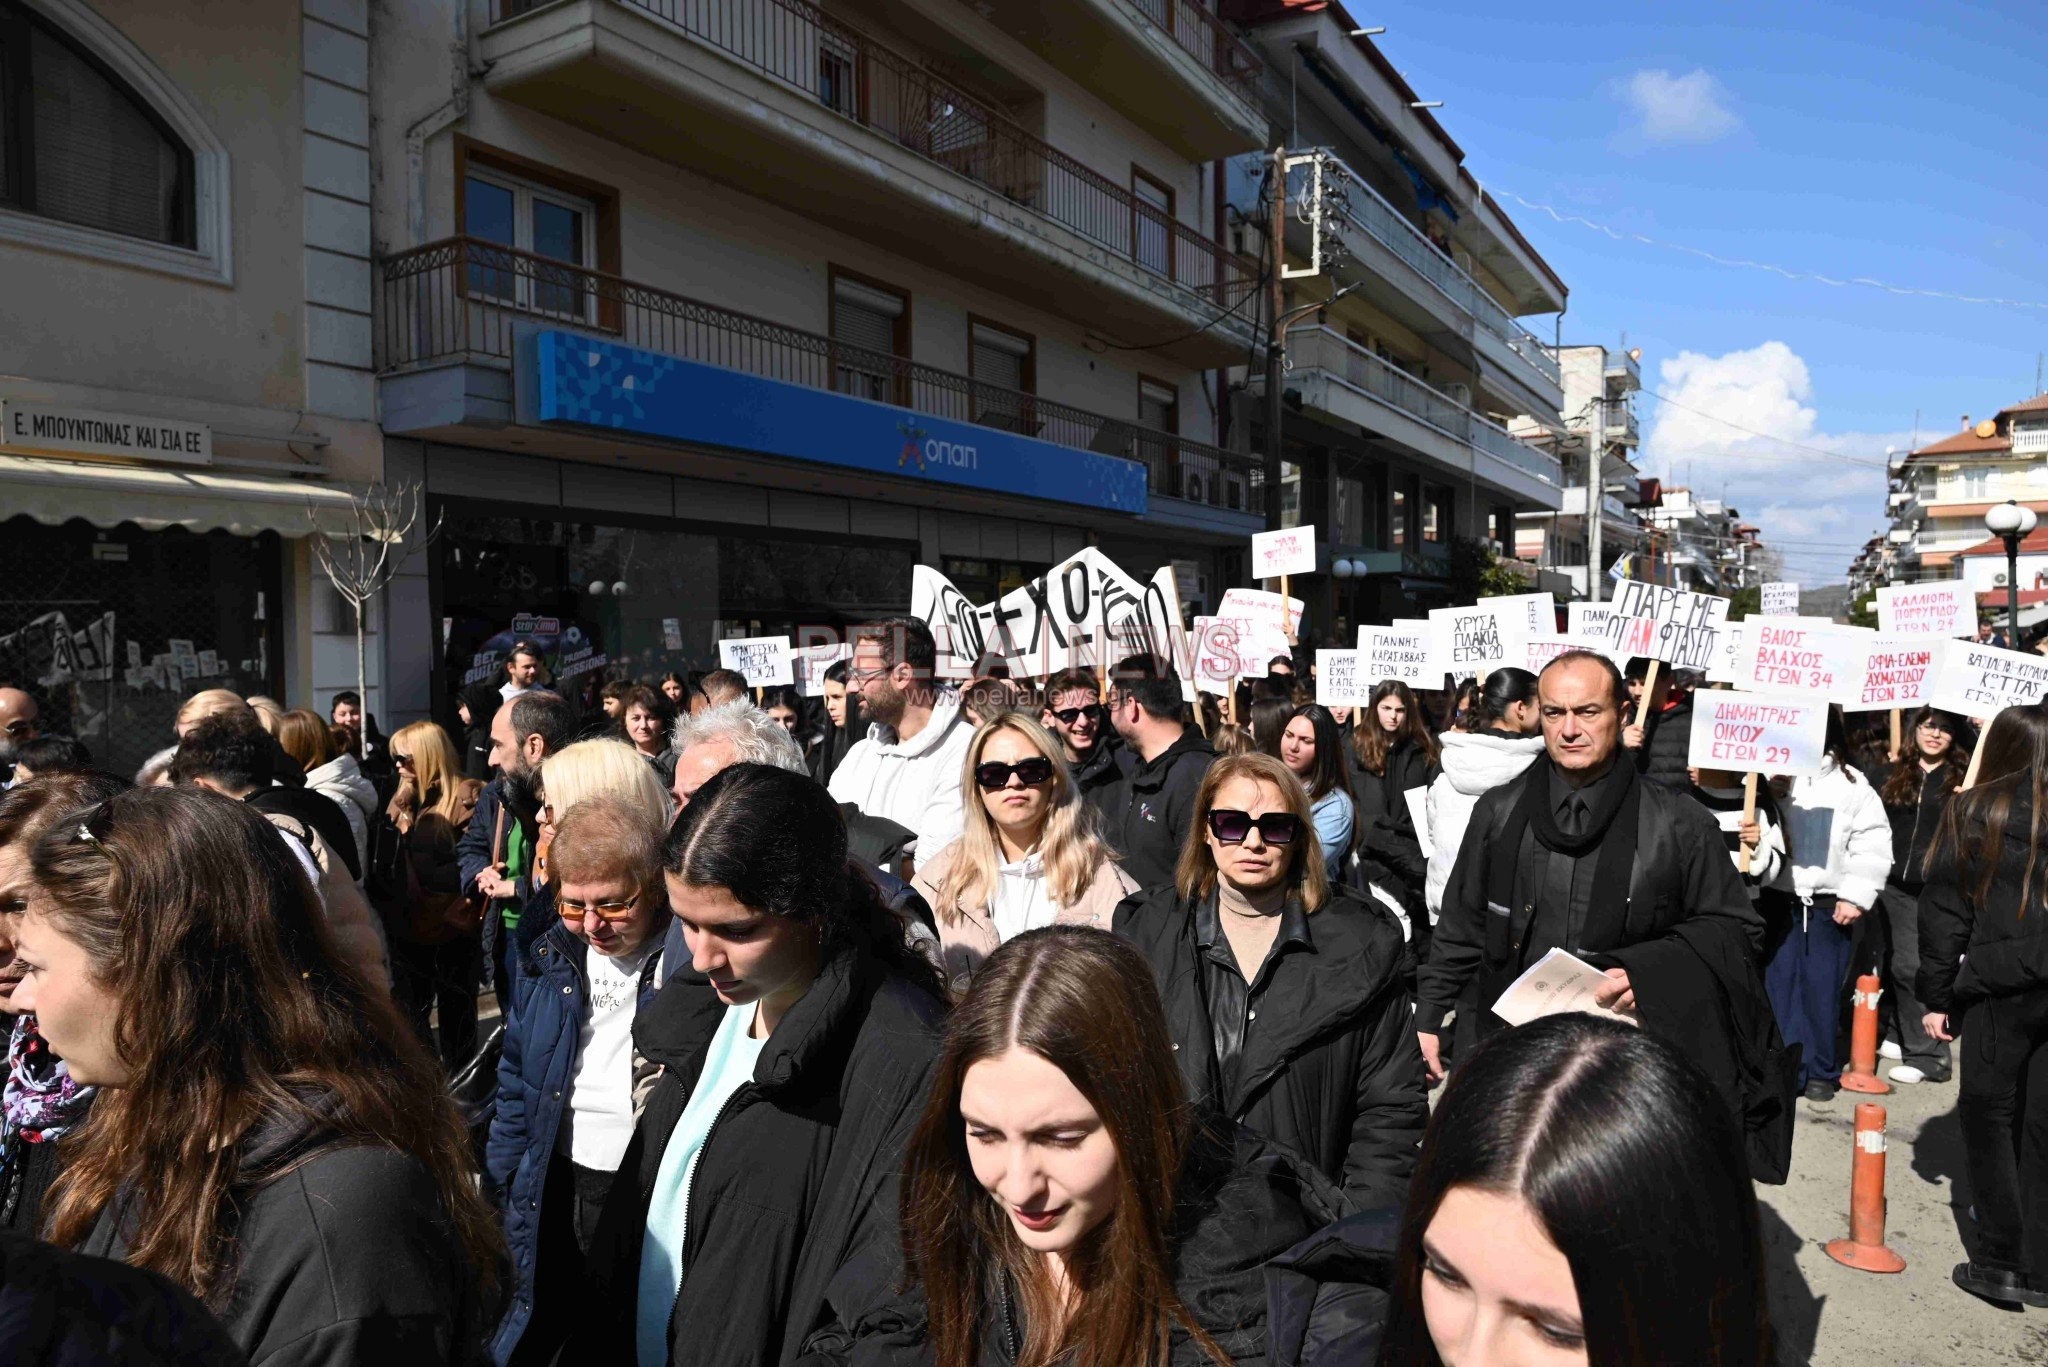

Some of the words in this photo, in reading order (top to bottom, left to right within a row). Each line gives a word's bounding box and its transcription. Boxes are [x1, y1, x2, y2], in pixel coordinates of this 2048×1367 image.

[33, 413, 132, 447] ΜΠΟΥΝΤΩΝΑΣ
[136, 426, 157, 449] ΚΑΙ
[160, 429, 183, 452] ΣΙΑ
[186, 432, 202, 453] ΕΕ
[1620, 581, 1688, 624] ΠΑΡΕ
[1687, 594, 1723, 629] ΜΕ
[1892, 592, 1954, 608] ΚΑΛΛΙΟΠΗ
[1454, 614, 1498, 632] ΧΡΥΣΑ
[1373, 634, 1420, 648] ΓΙΑΝΝΗΣ
[1454, 630, 1500, 647] ΠΛΑΚΙΑ
[1760, 626, 1807, 648] ΒΑΙΟΣ
[1371, 650, 1427, 662] ΚΑΡΑΣΑΒΒΑΣ
[1453, 645, 1487, 662] ΕΤΩΝ
[1488, 645, 1504, 660] 20
[1757, 646, 1824, 669] ΒΛΑΧΟΣ
[1867, 651, 1932, 671] ΟΦΙΑ-ΕΛΕΝΗ
[1329, 667, 1357, 677] ΕΥΑΓΓ
[1370, 664, 1398, 676] ΕΤΩΝ
[1404, 666, 1419, 677] 28
[1754, 665, 1801, 685] ΕΤΩΝ
[1809, 671, 1833, 689] 34
[1864, 668, 1926, 688] ΑΧΜΑΖΙΔΟΥ
[1861, 687, 1895, 704] ΕΤΩΝ
[1902, 684, 1919, 699] 32
[1965, 689, 2001, 706] ΕΤΩΝ
[1715, 703, 1801, 725] ΔΗΜΗΤΡΗΣ
[1714, 722, 1765, 743] ΟΙΚΟΥ
[1711, 742, 1758, 761] ΕΤΩΝ
[1765, 746, 1791, 764] 29
